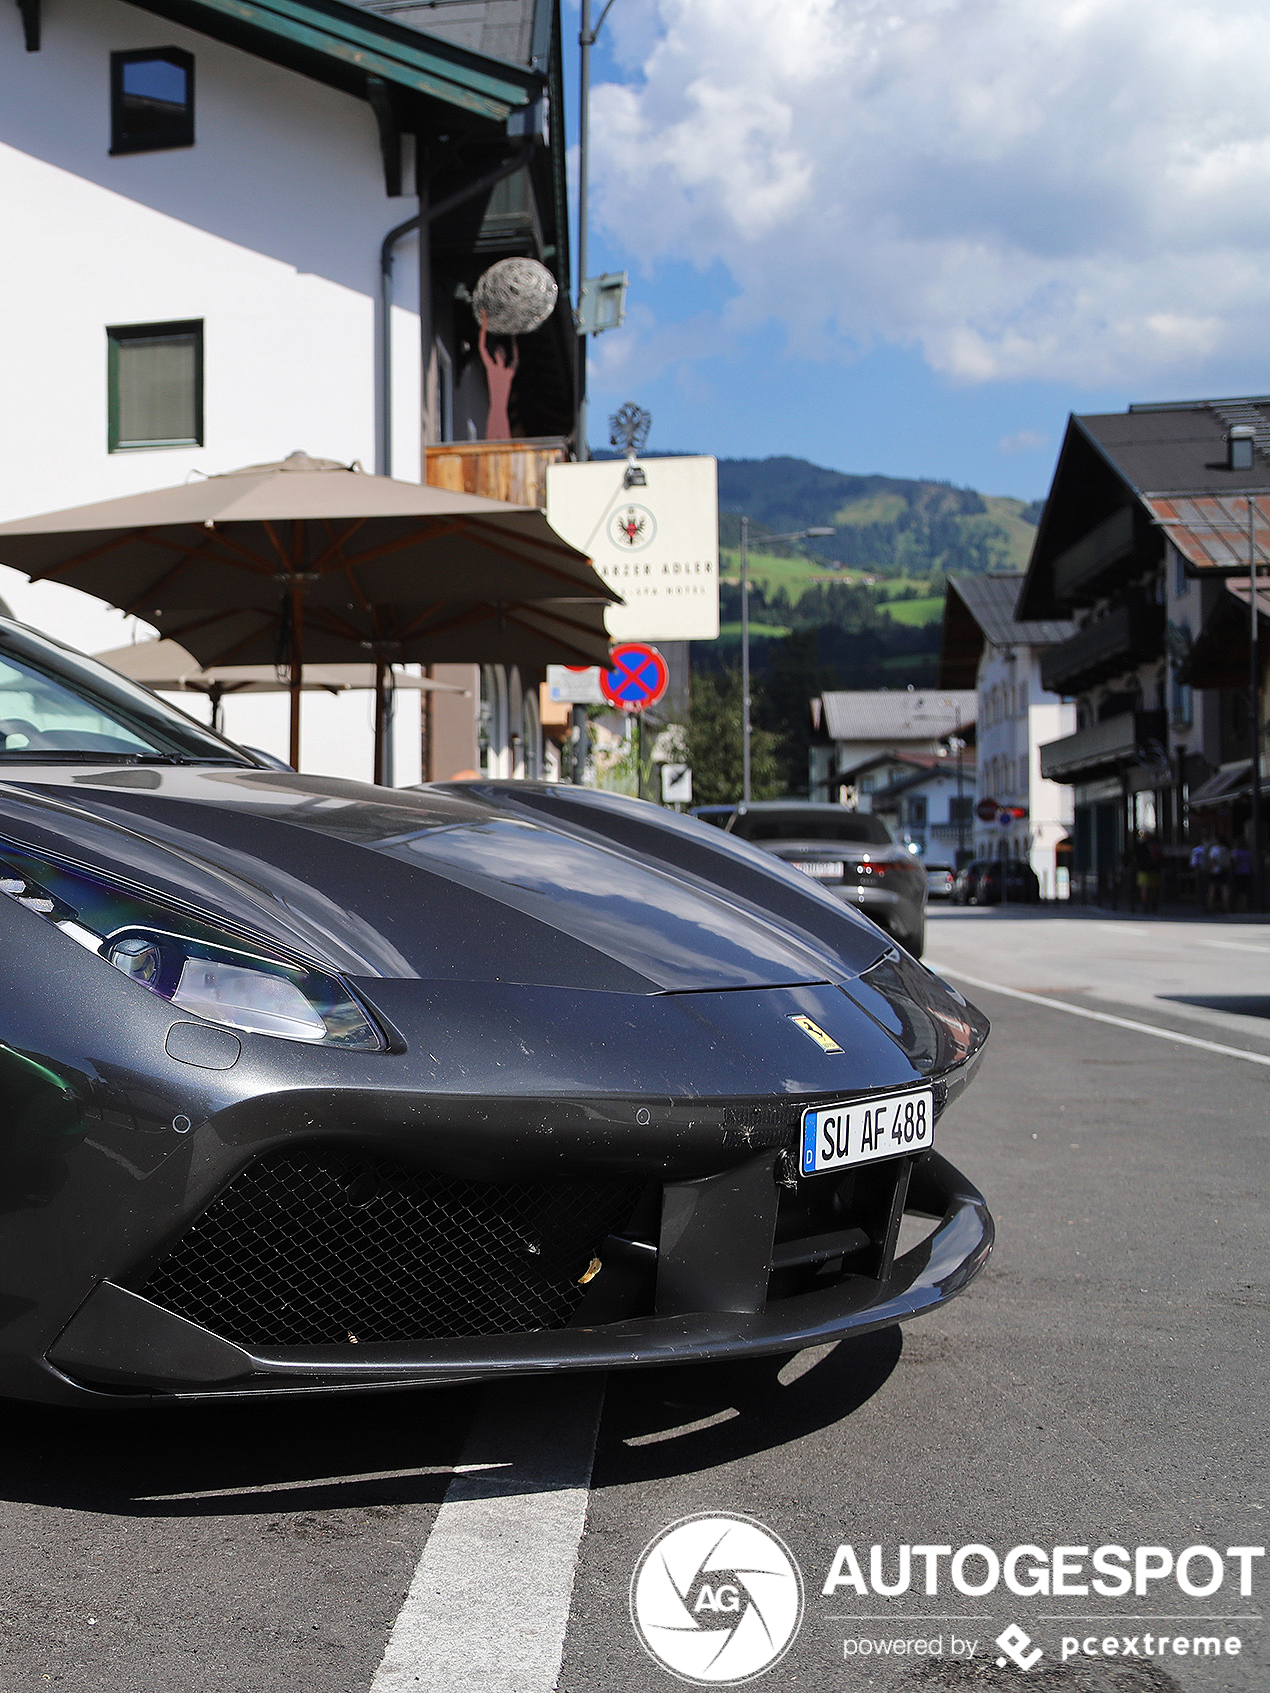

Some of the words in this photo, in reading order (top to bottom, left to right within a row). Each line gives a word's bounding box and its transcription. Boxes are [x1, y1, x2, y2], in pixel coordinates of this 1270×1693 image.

[603, 563, 651, 576] ARZER
[661, 560, 712, 575] ADLER
[821, 1114, 850, 1161] SU
[860, 1106, 887, 1153] AF
[891, 1099, 926, 1145] 488
[806, 1149, 813, 1165] D
